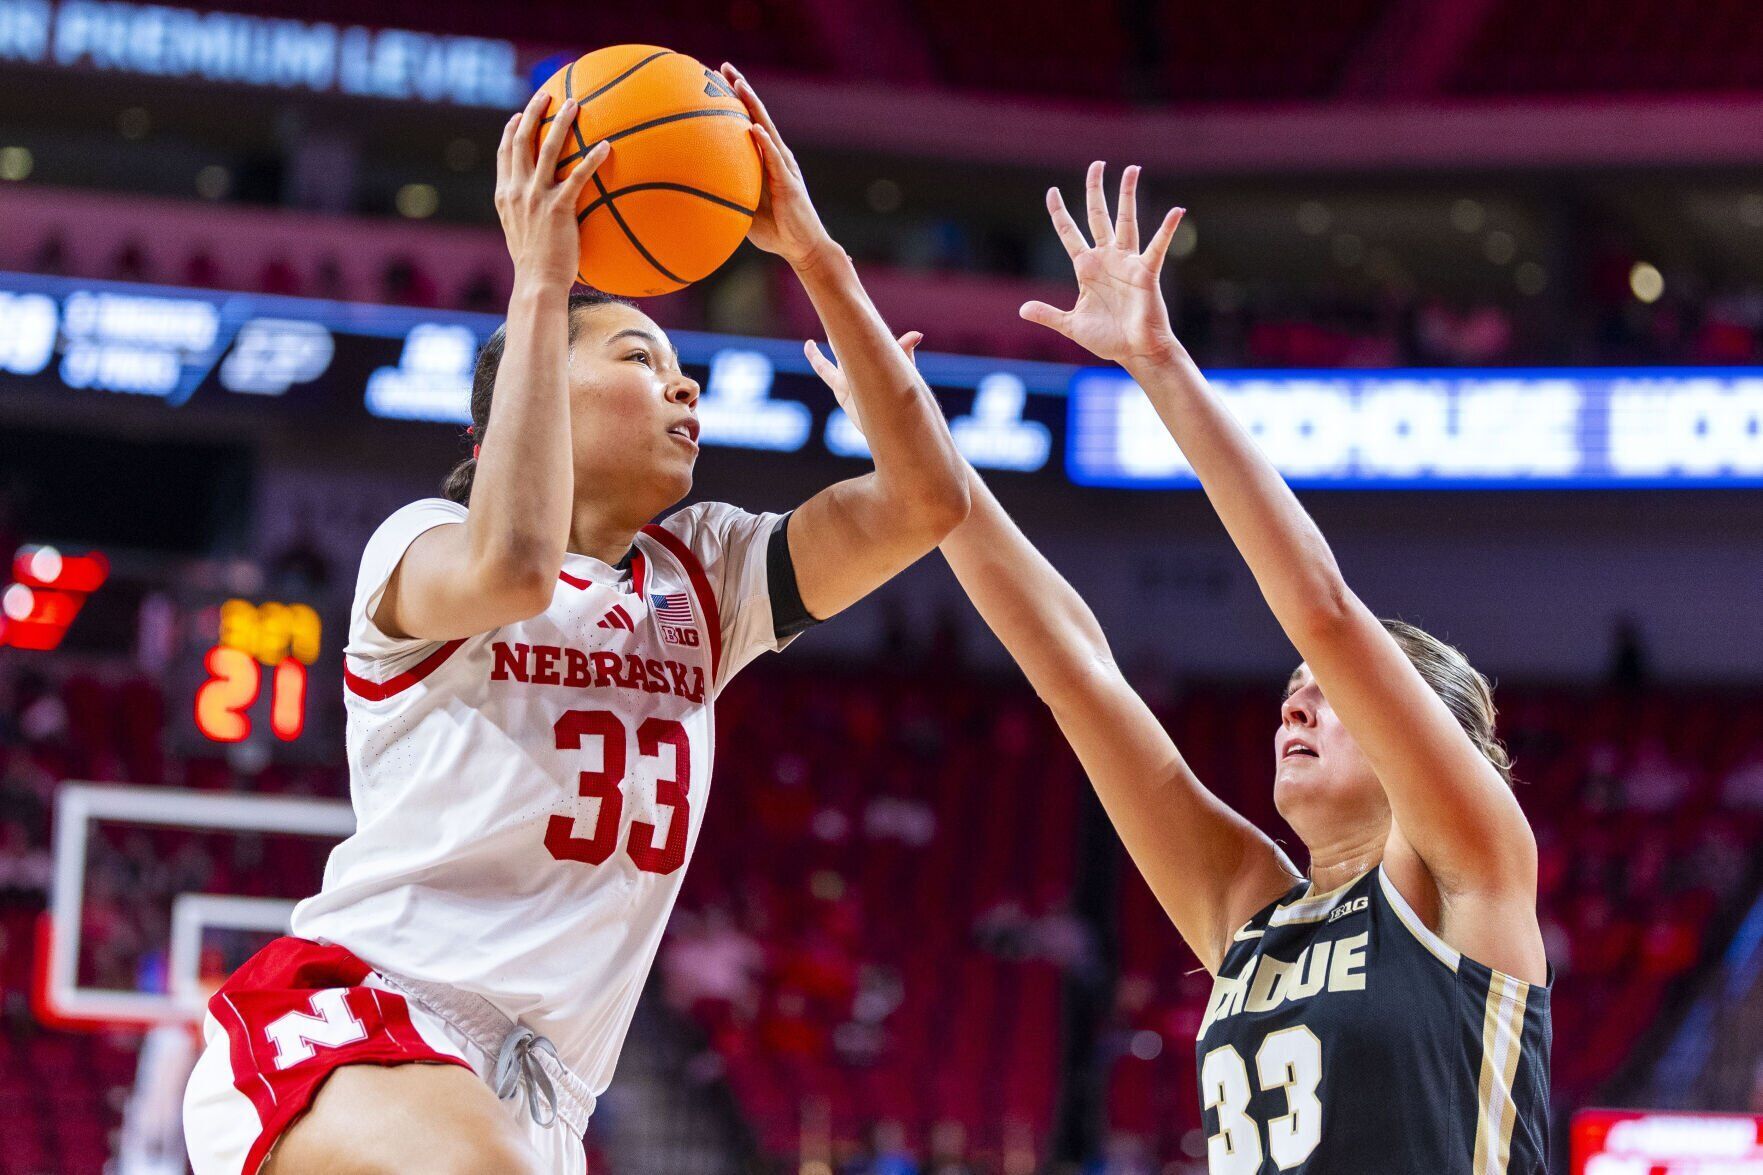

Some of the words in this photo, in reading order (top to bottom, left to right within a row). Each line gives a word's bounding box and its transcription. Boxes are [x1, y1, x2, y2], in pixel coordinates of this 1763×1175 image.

[55, 0, 336, 90] PREMIUM
[195, 645, 307, 742] 21
[491, 642, 704, 704] NEBRASKA
[544, 709, 691, 875] 33
[264, 987, 368, 1070] N
[1202, 1024, 1322, 1175] 33
